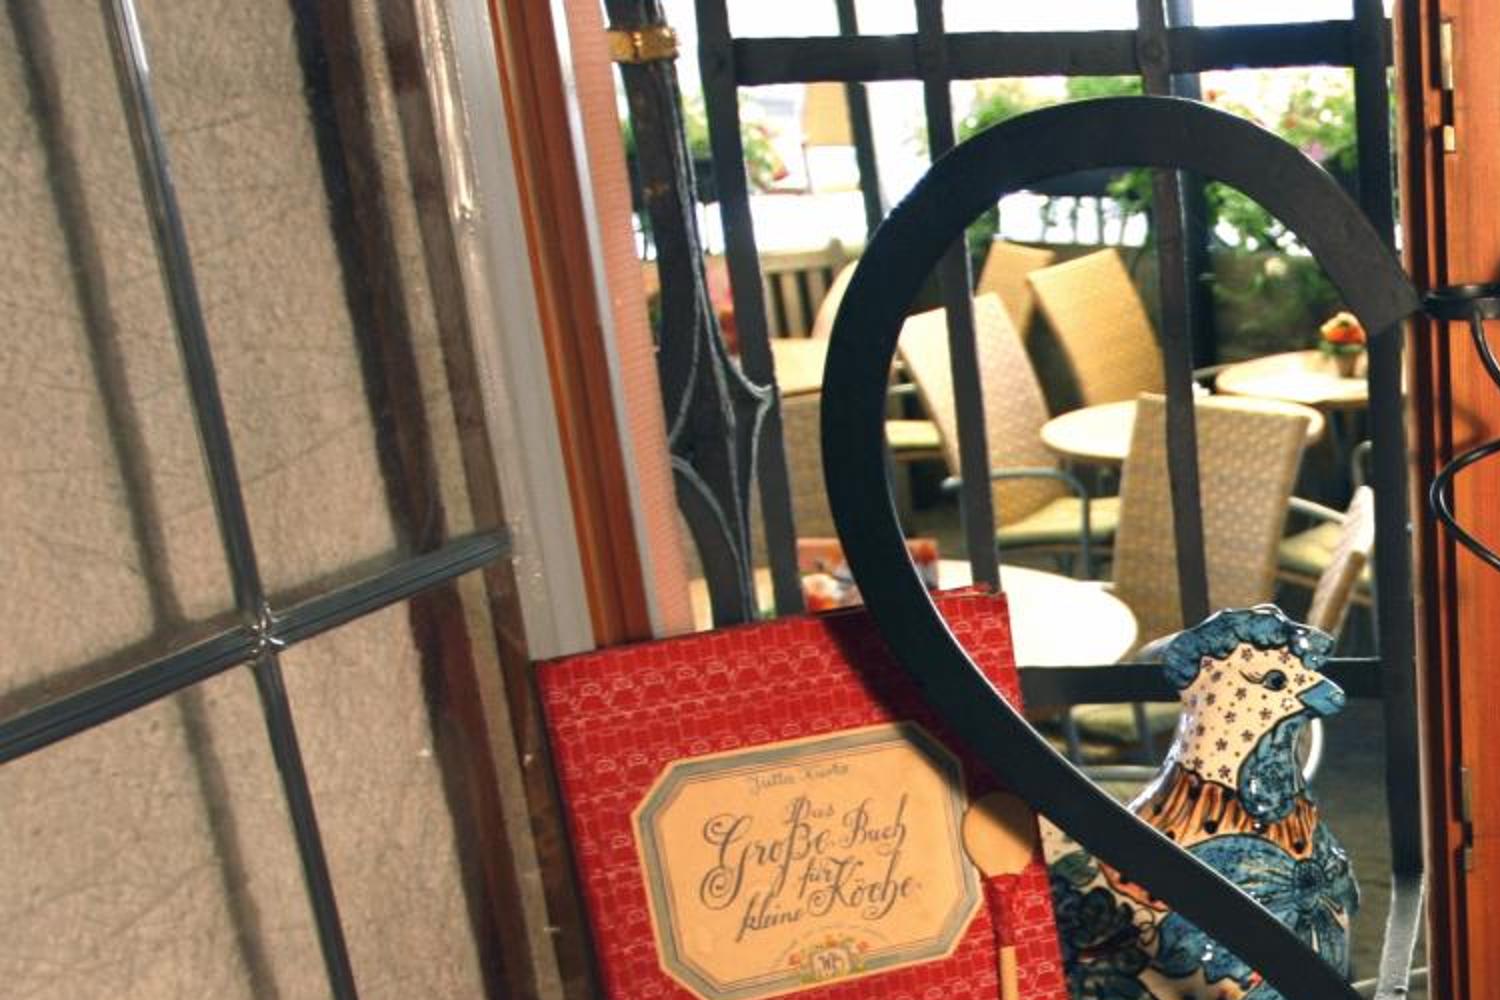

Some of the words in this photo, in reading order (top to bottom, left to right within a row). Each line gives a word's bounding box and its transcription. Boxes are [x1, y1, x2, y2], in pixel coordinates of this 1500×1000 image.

[784, 796, 835, 825] Das
[700, 813, 832, 911] Große
[842, 793, 908, 856] Buch
[799, 857, 833, 900] für
